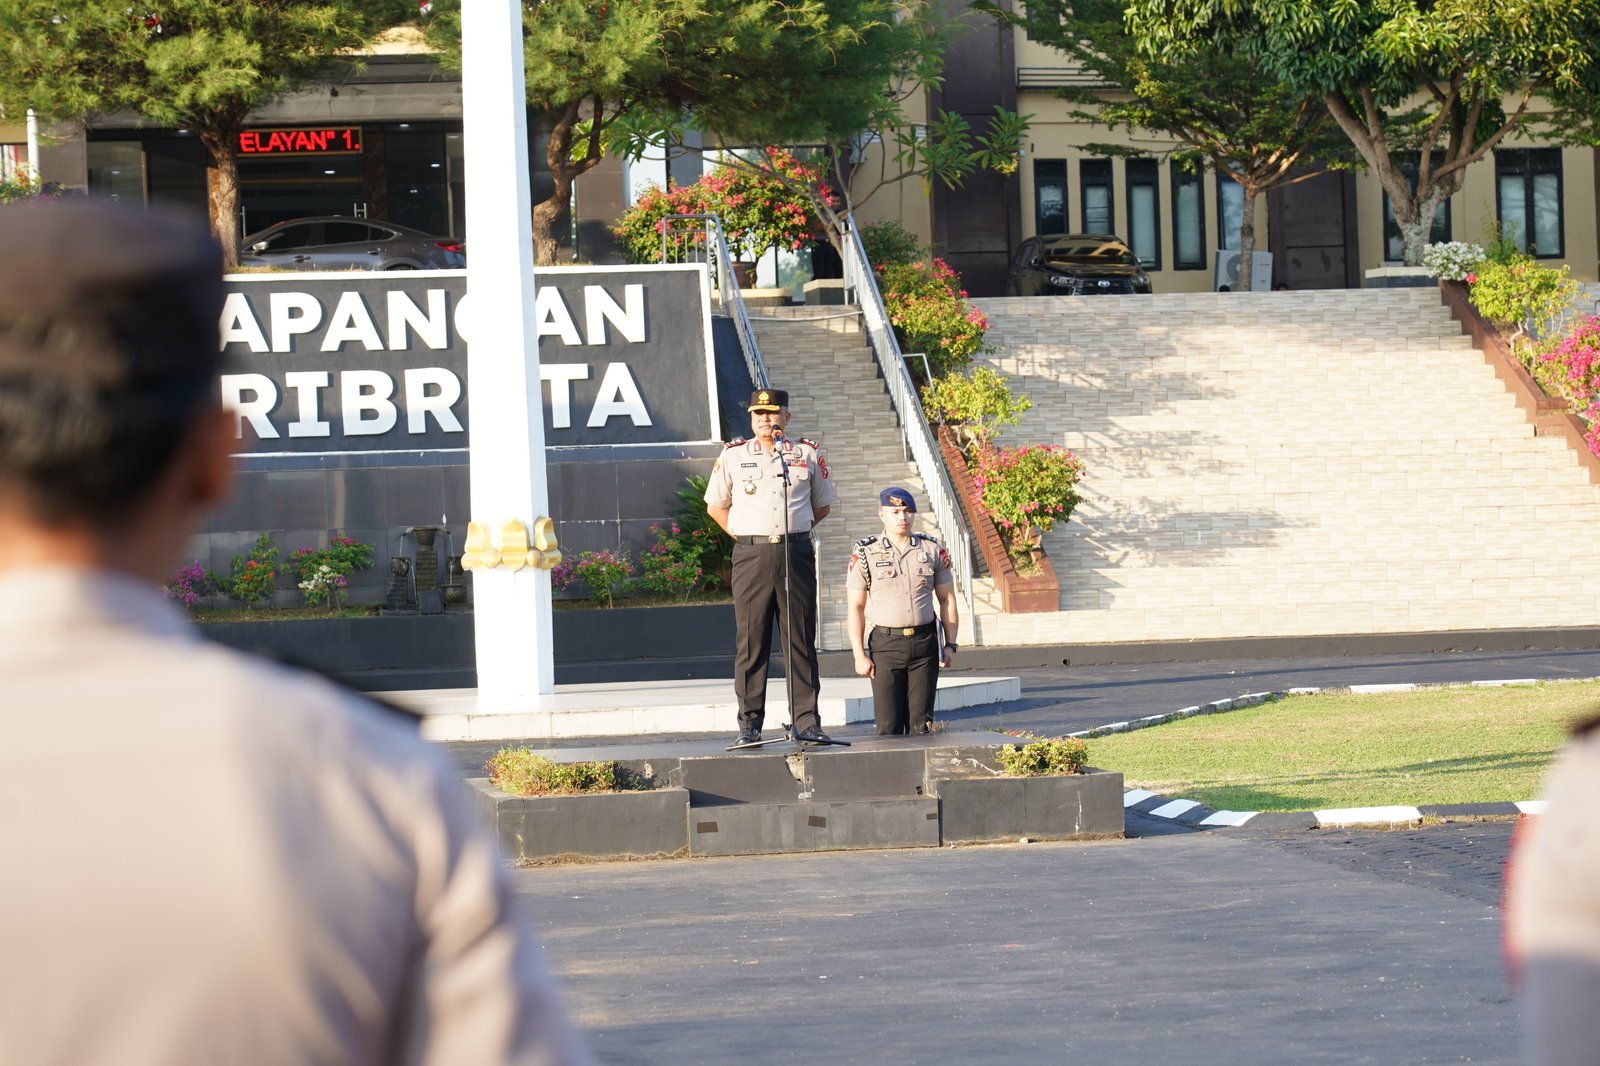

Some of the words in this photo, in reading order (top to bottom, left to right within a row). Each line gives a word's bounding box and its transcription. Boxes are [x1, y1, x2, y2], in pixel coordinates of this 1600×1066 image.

[343, 129, 360, 150] 1.
[218, 284, 646, 353] APANAN
[220, 362, 653, 439] RIBRTA
